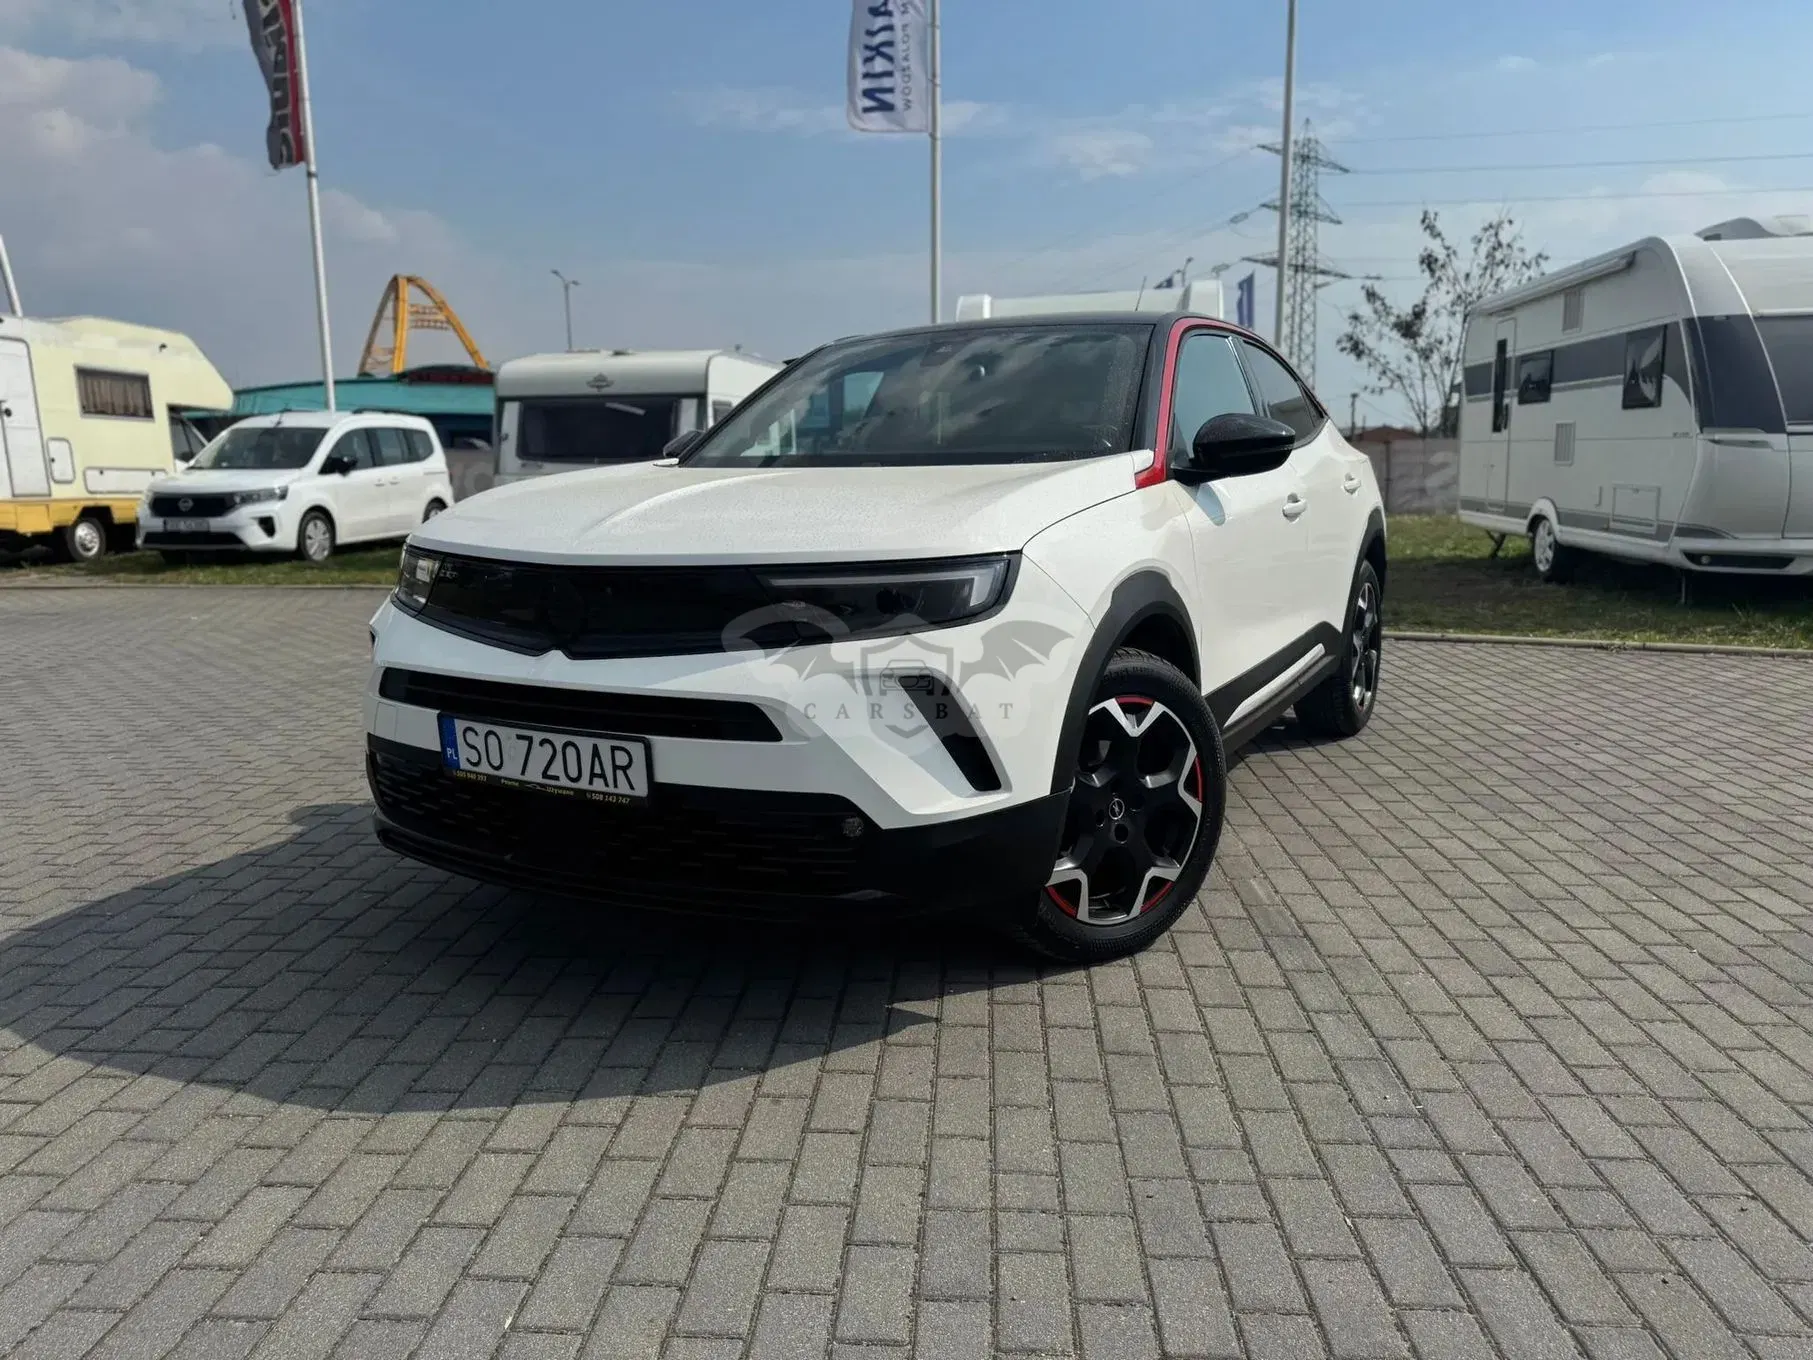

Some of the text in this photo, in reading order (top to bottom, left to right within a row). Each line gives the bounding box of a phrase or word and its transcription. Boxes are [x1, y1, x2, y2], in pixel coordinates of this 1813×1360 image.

[446, 747, 458, 760] PL
[462, 726, 635, 791] SO 720AR
